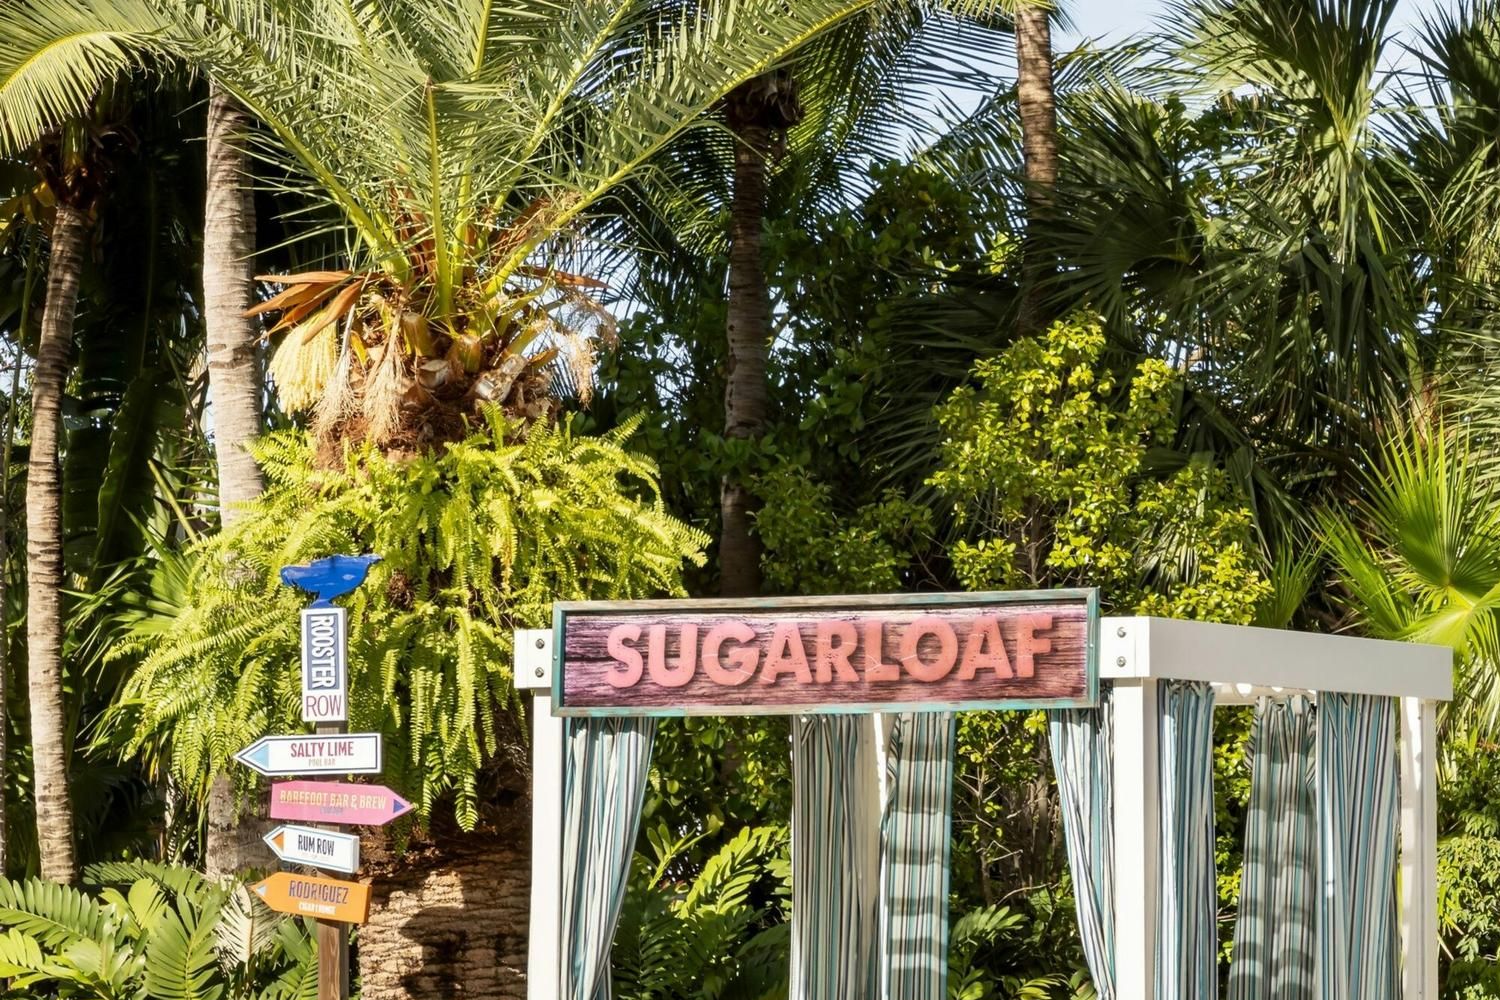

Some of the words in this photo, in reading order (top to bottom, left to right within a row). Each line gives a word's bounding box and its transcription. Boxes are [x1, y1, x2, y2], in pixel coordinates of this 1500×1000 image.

[311, 615, 336, 688] ROOSTER
[604, 612, 1055, 690] SUGARLOAF
[306, 694, 342, 718] ROW
[290, 742, 325, 758] SALTY
[327, 741, 355, 757] LIME
[280, 790, 328, 806] BAREFOOT
[329, 793, 349, 808] BAR
[350, 795, 358, 810] &
[359, 795, 387, 810] BREW
[297, 834, 315, 853] RUM
[316, 837, 335, 857] ROW
[288, 879, 349, 905] RODRIGUEZ
